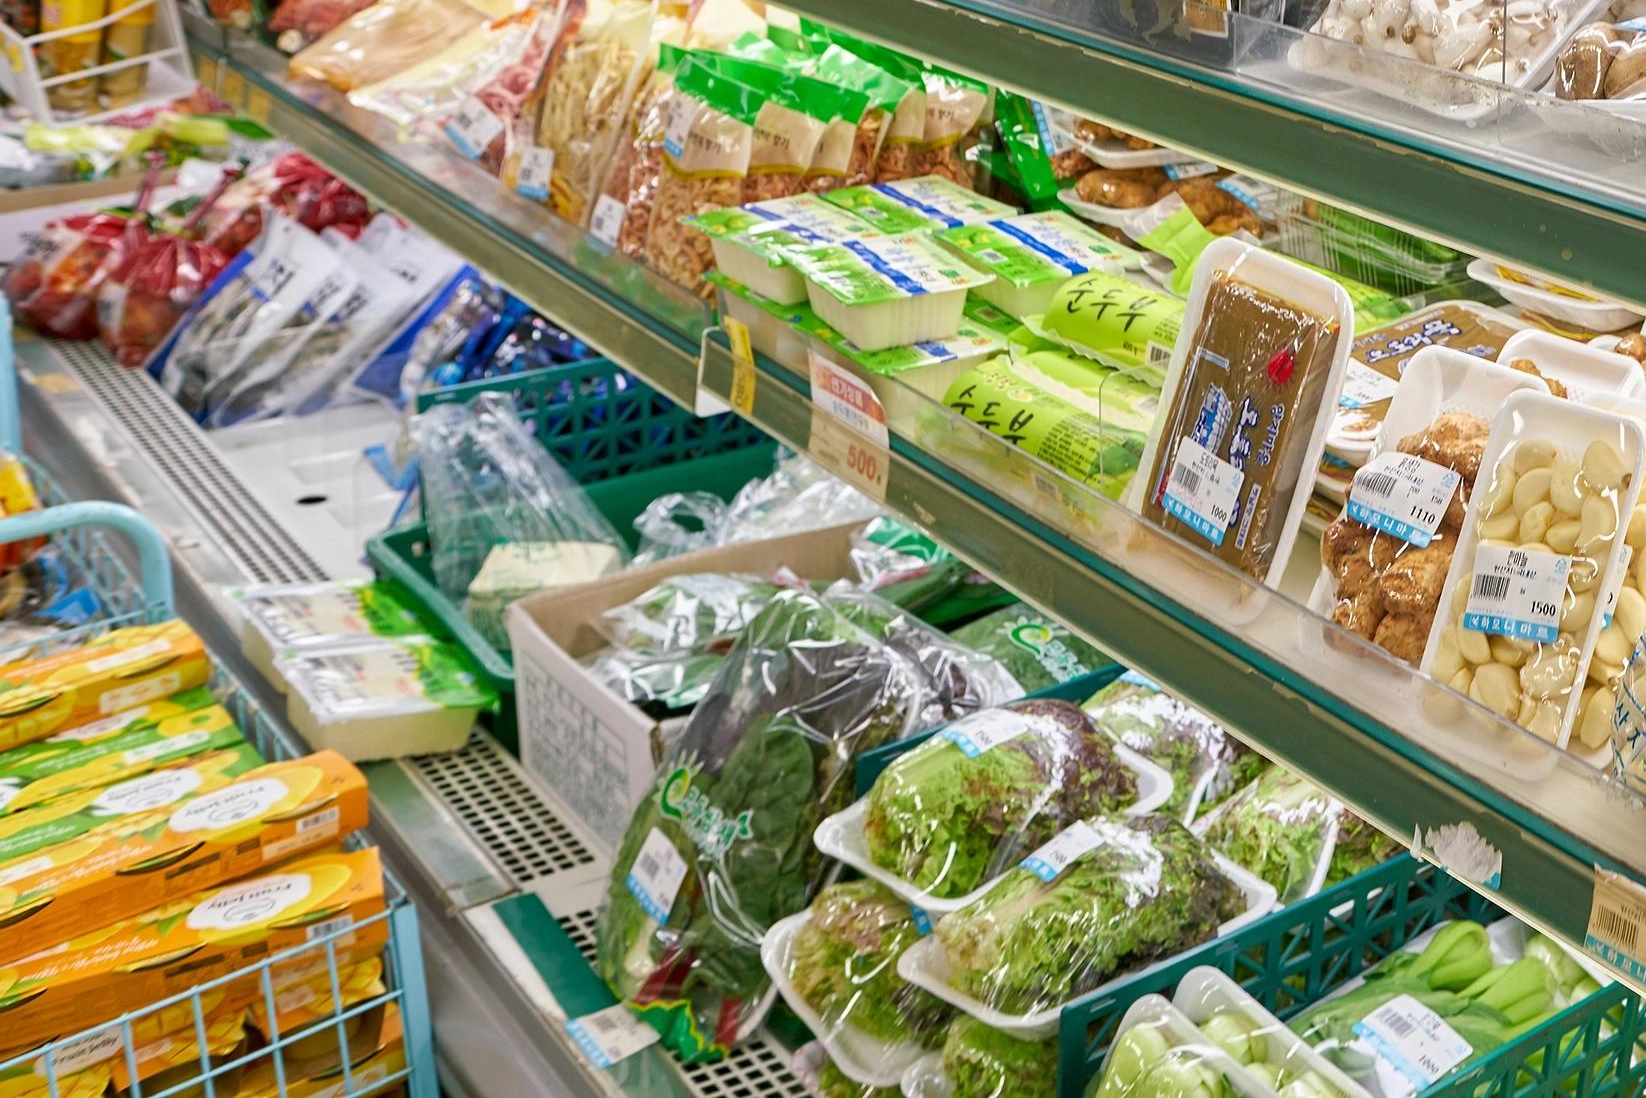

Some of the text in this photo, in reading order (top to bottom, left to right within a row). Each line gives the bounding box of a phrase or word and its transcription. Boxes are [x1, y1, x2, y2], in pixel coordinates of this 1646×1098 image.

[1066, 277, 1158, 333] 순두부
[1210, 503, 1228, 523] 1000
[1409, 504, 1437, 526] 1110
[1359, 506, 1430, 543] 하모니마트
[1530, 600, 1558, 618] 1500
[1480, 617, 1550, 640] 하모니마트
